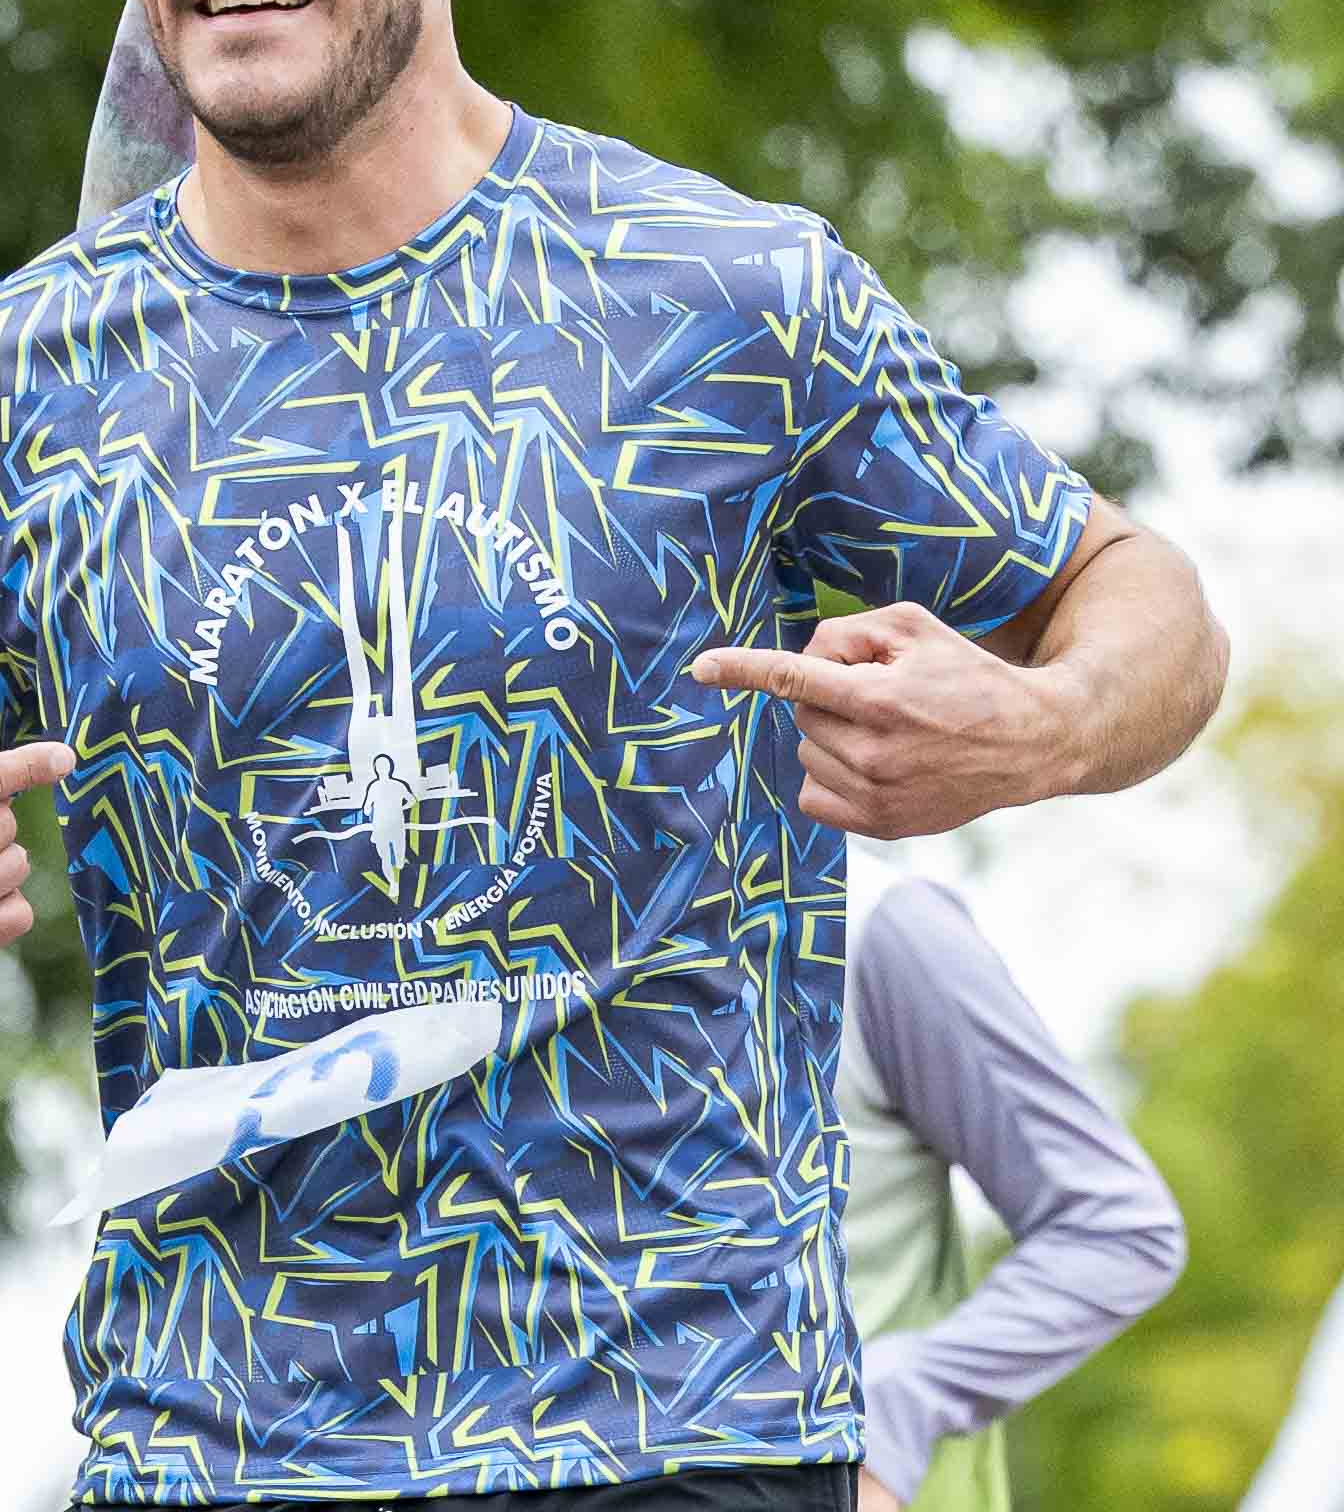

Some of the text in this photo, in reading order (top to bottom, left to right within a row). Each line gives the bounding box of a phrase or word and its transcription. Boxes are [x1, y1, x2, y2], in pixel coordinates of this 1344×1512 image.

[189, 479, 578, 686] MARATÓN X EL AUTISMO
[315, 917, 423, 940] INCLUSIÓN
[425, 917, 440, 935] Y
[445, 868, 519, 931] ENERGÍA
[512, 772, 553, 867] POSITIVA
[245, 970, 585, 1019] ASOCIACIÓN CIVIL TGD PADRES UNIDOS
